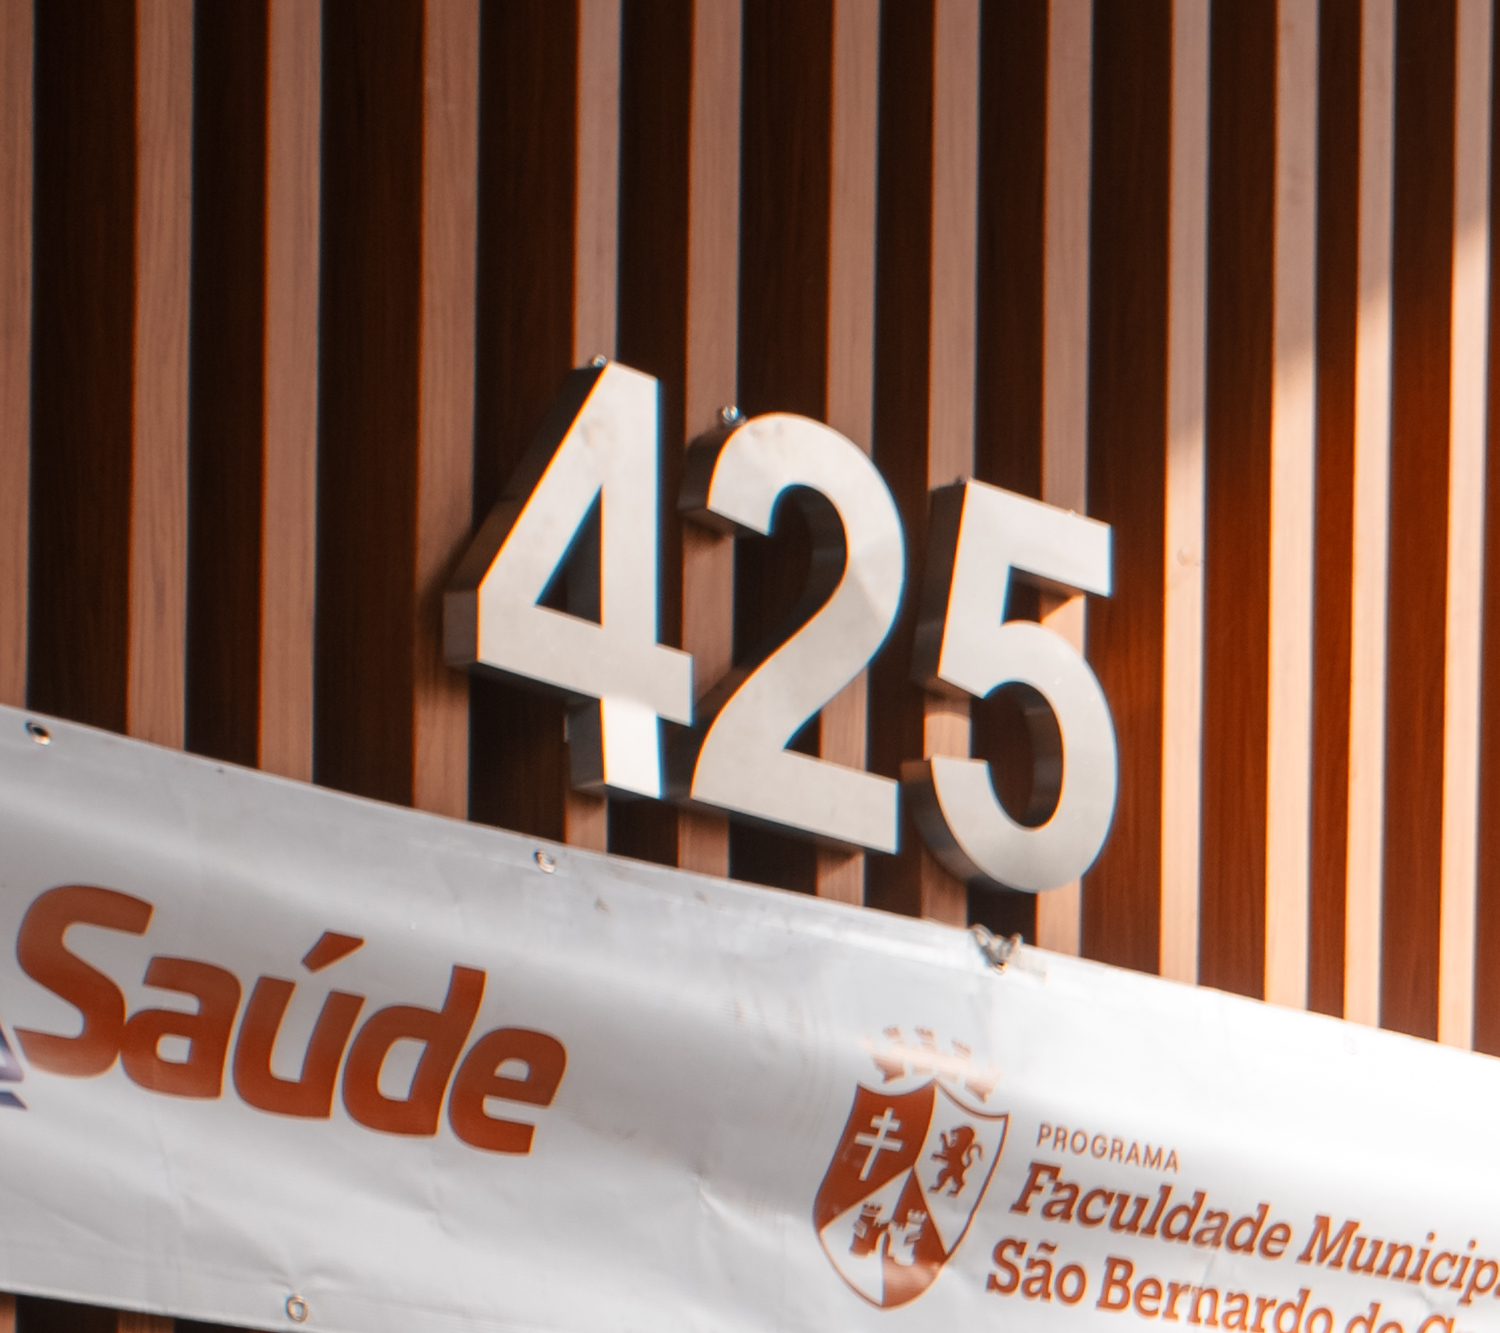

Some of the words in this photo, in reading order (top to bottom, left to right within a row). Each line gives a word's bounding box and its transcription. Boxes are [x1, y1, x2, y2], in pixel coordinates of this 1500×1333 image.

[446, 361, 1119, 893] 425
[15, 884, 567, 1157] Saúde
[1036, 1122, 1180, 1174] PROGRAMA
[1009, 1162, 1291, 1259] Faculdade
[986, 1236, 1087, 1306] São
